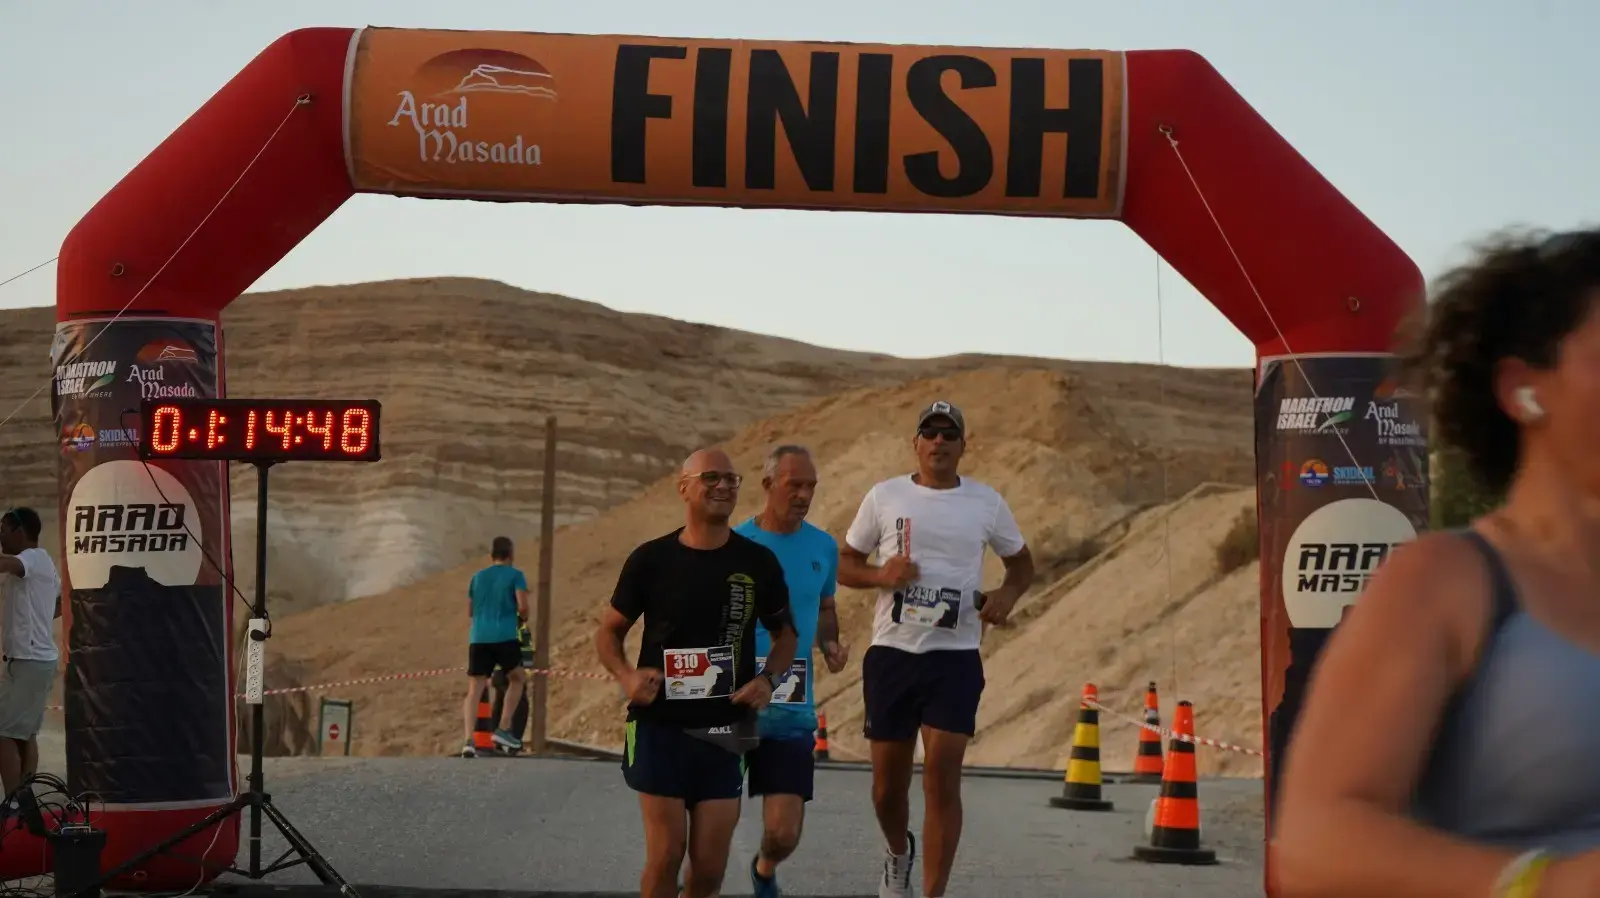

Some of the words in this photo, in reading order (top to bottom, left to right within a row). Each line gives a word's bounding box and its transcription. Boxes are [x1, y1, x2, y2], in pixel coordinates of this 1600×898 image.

[387, 90, 467, 128] Arad
[611, 44, 1103, 199] FINISH
[420, 128, 541, 164] Masada
[56, 361, 117, 380] MARATHON
[126, 364, 164, 383] Arad
[57, 377, 86, 395] ISRAEL
[141, 381, 195, 401] Masada
[1279, 397, 1356, 414] MARATHON
[1364, 401, 1399, 420] Arad
[1276, 413, 1318, 429] ISRAEL
[99, 428, 140, 442] SKIDEAL
[74, 504, 185, 532] ARAD
[74, 534, 188, 554] MASADA
[1298, 543, 1402, 570] ARA
[729, 583, 744, 620] ARAD
[673, 654, 699, 670] 310
